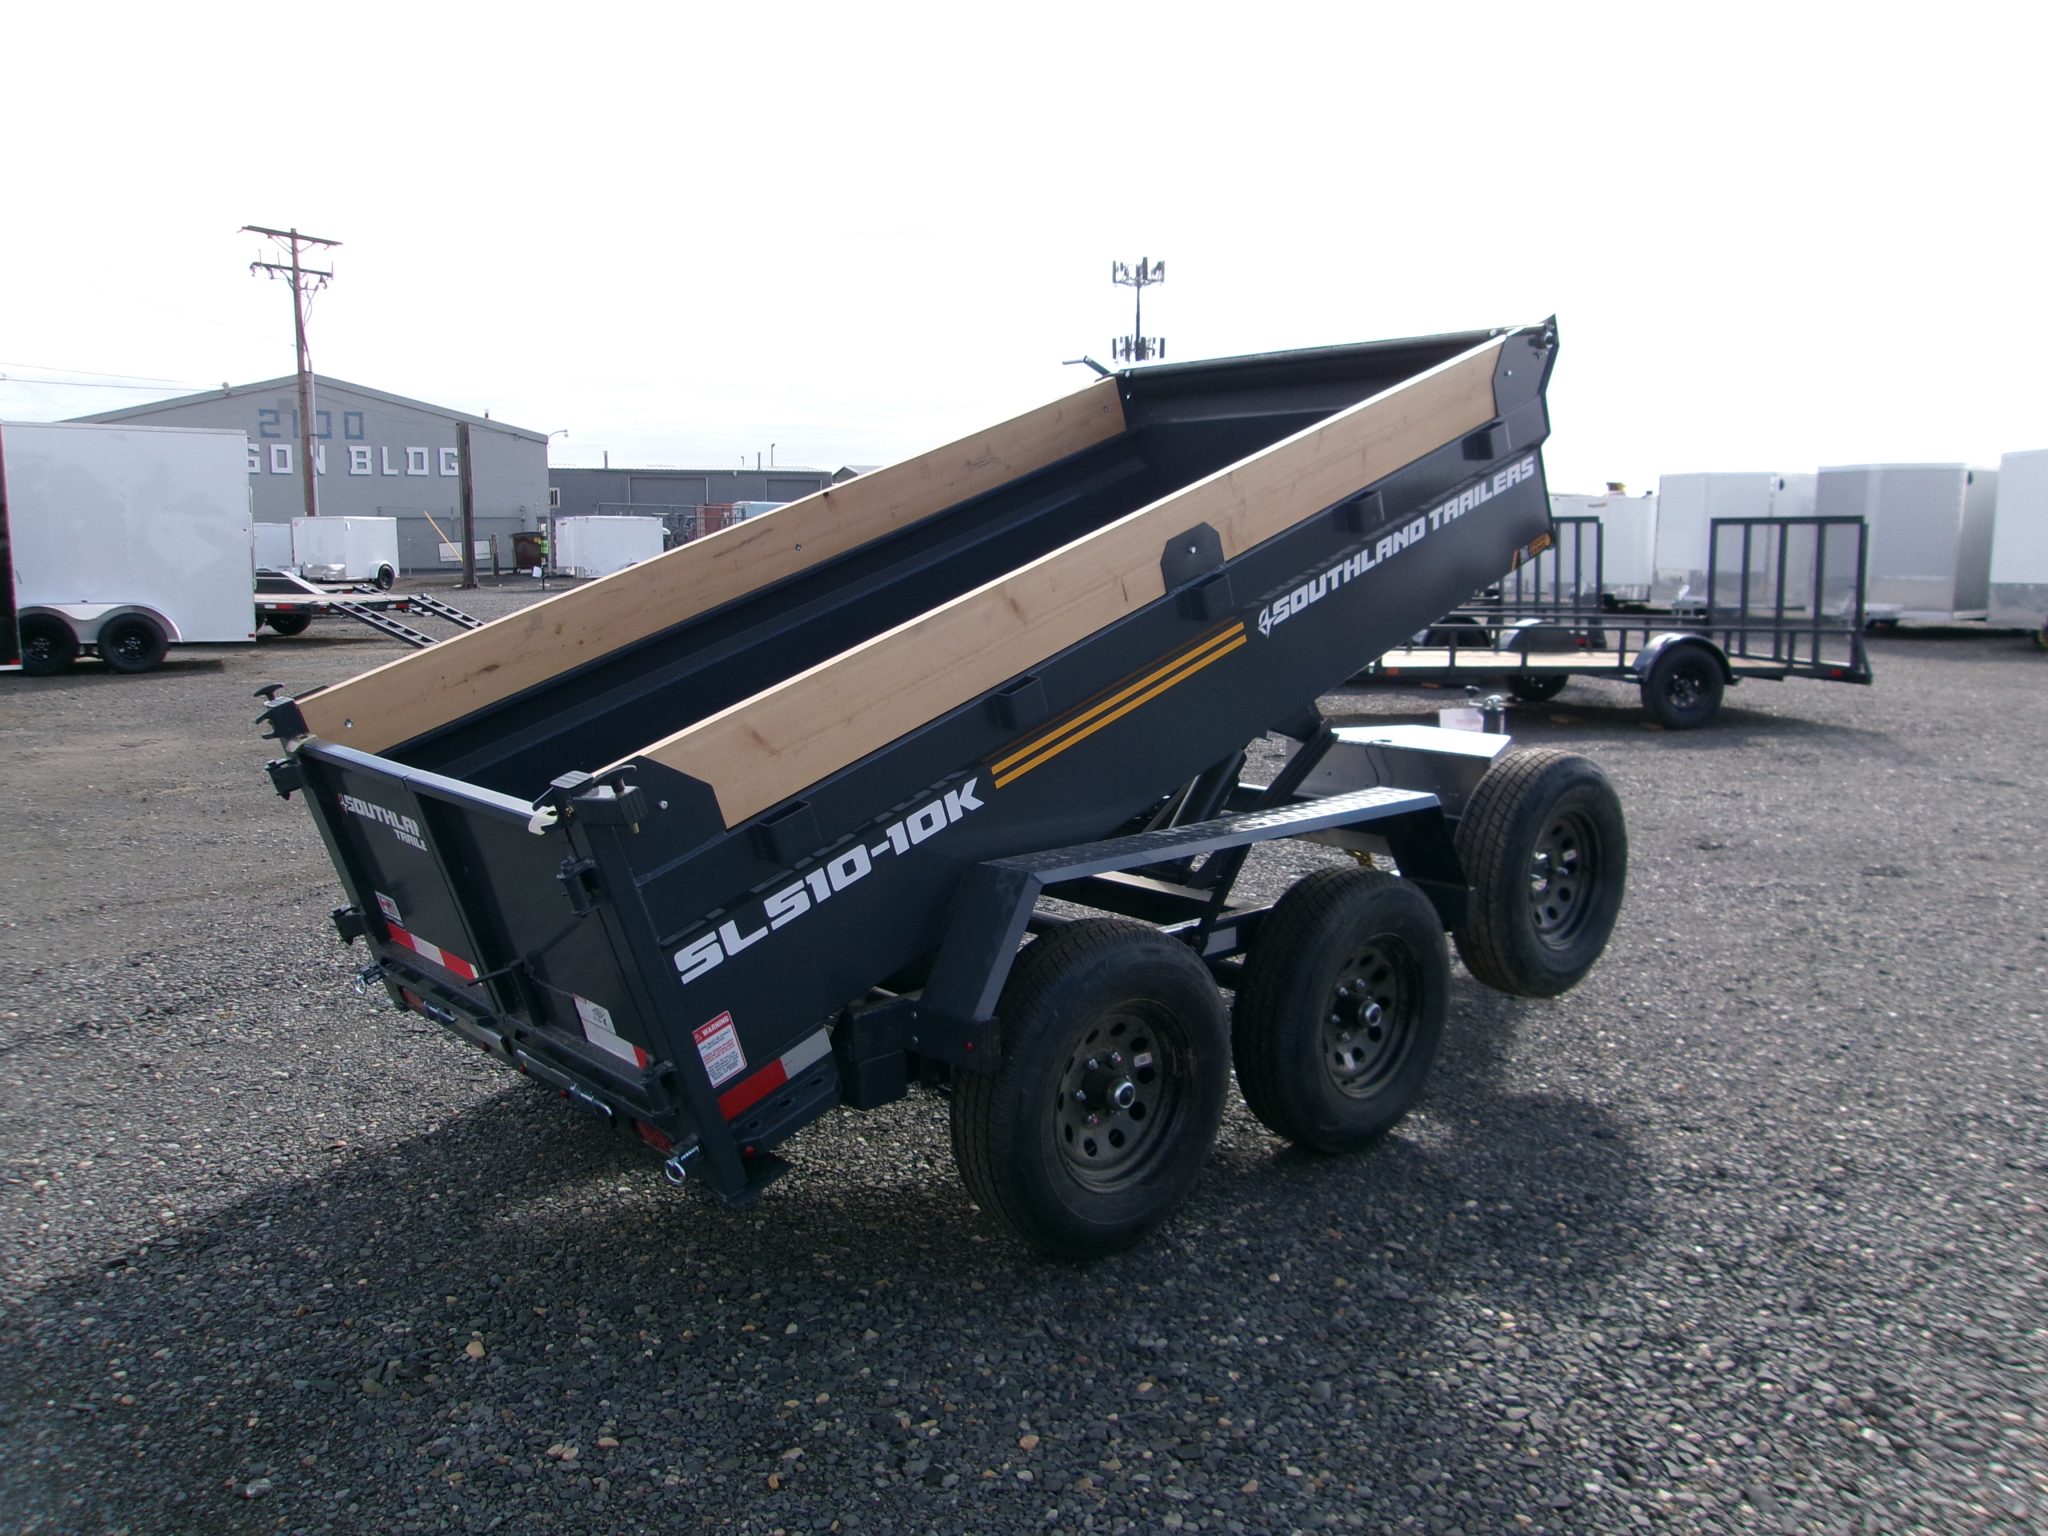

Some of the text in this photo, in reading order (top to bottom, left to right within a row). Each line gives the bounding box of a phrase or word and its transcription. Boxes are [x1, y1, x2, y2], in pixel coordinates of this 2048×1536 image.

[349, 445, 459, 476] BLDG
[1272, 456, 1534, 627] SOUTHLAND TRAILERS
[702, 1015, 730, 1037] WARNING
